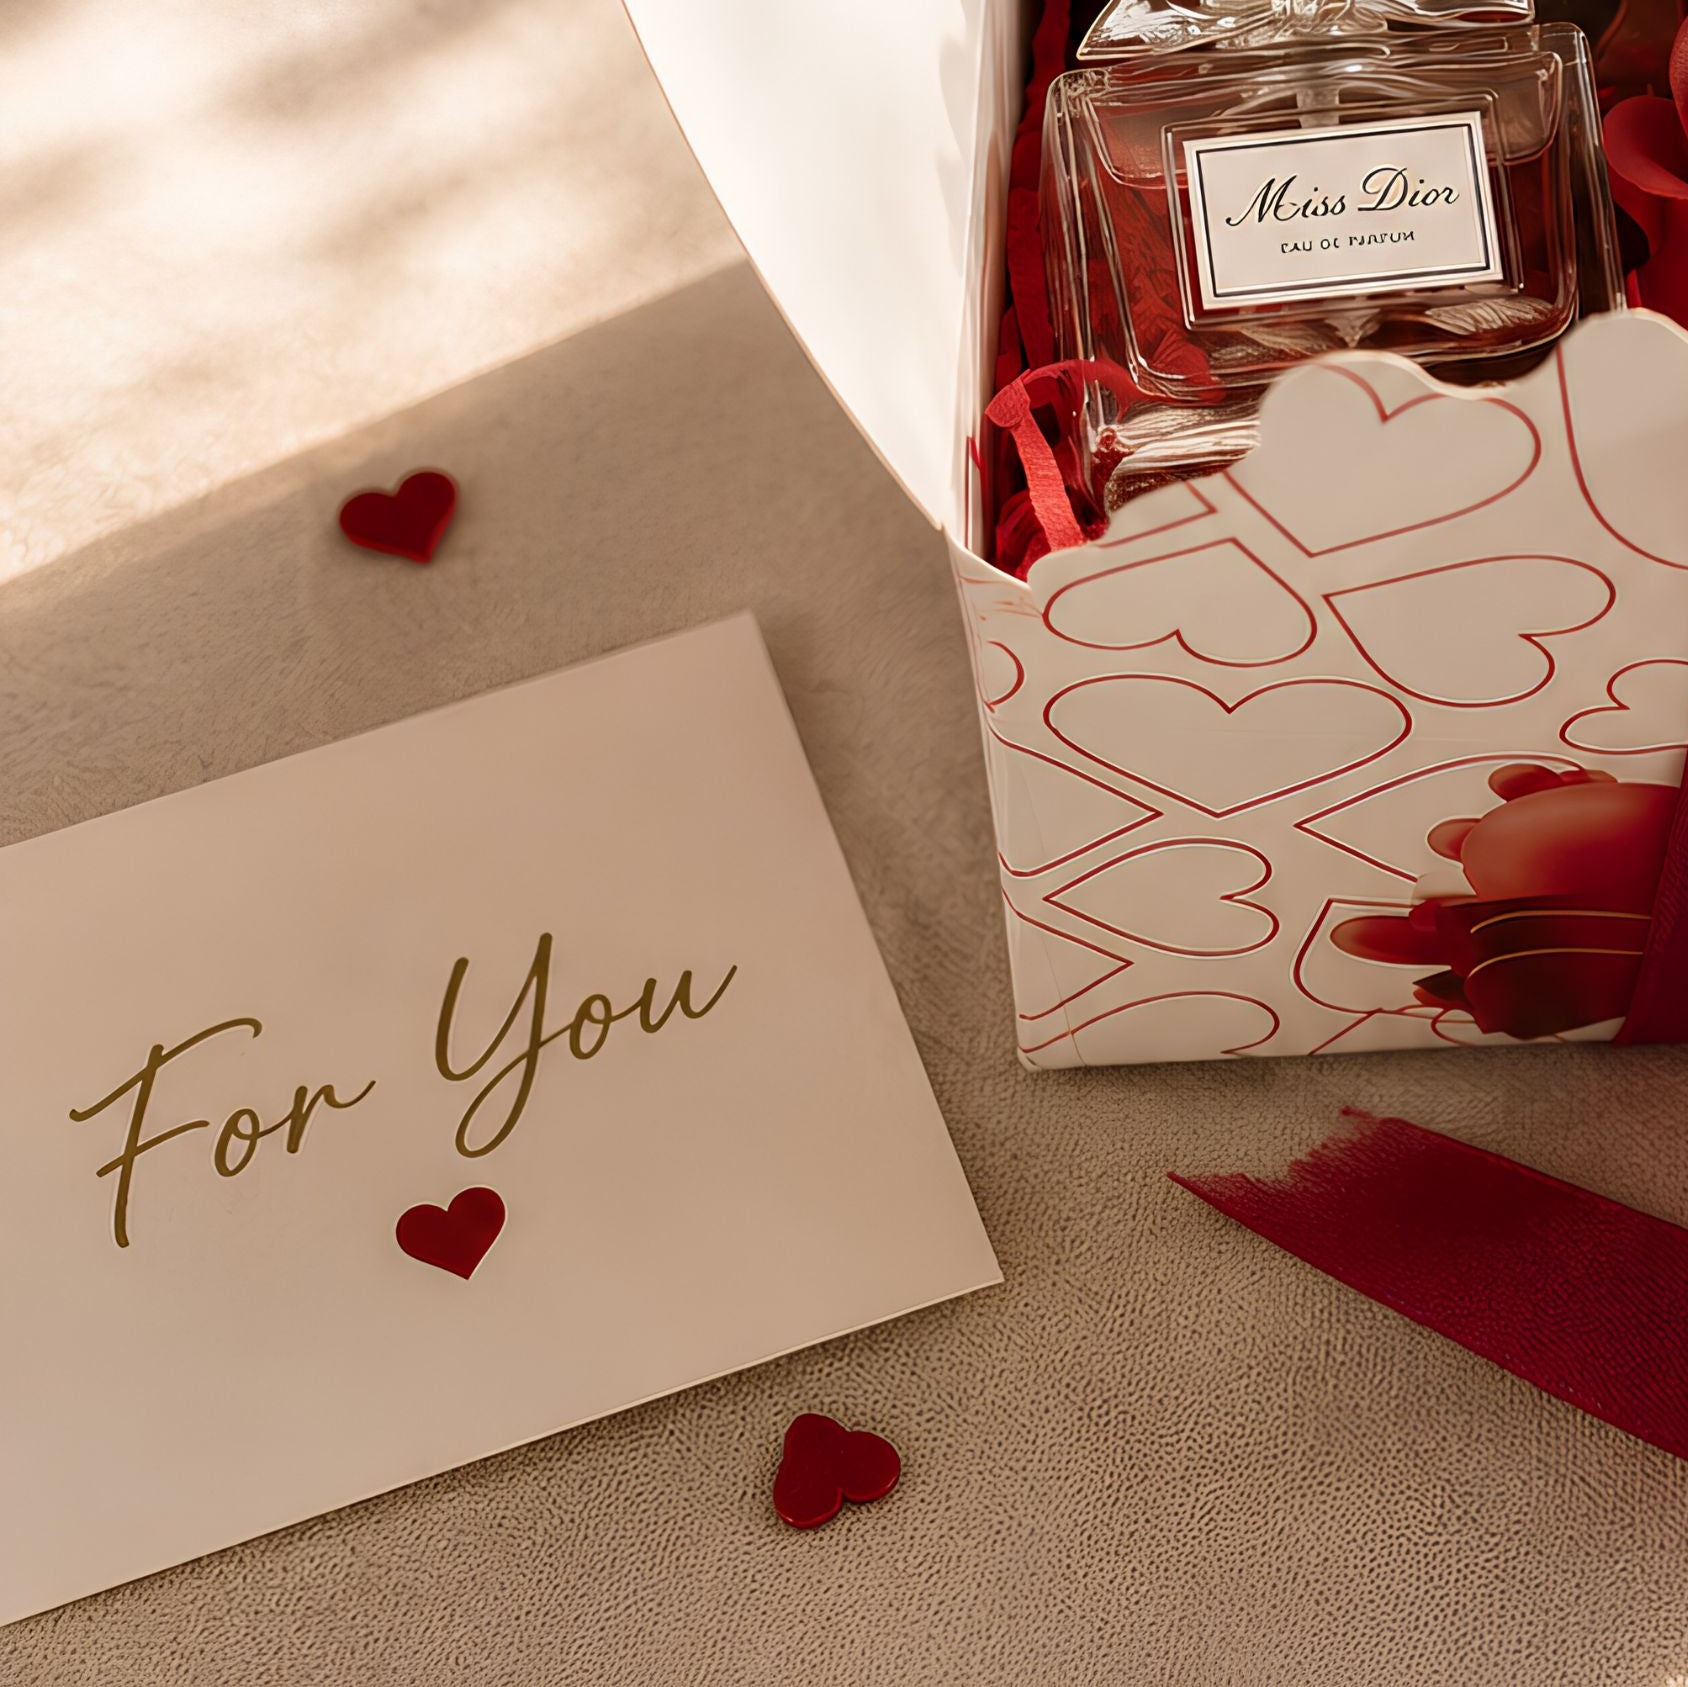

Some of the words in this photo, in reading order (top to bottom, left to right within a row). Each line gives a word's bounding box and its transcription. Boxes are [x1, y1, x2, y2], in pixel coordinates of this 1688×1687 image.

[1225, 175, 1346, 227] Miss
[1357, 166, 1459, 212] Dior
[69, 1017, 376, 1248] For
[435, 932, 737, 1158] You
